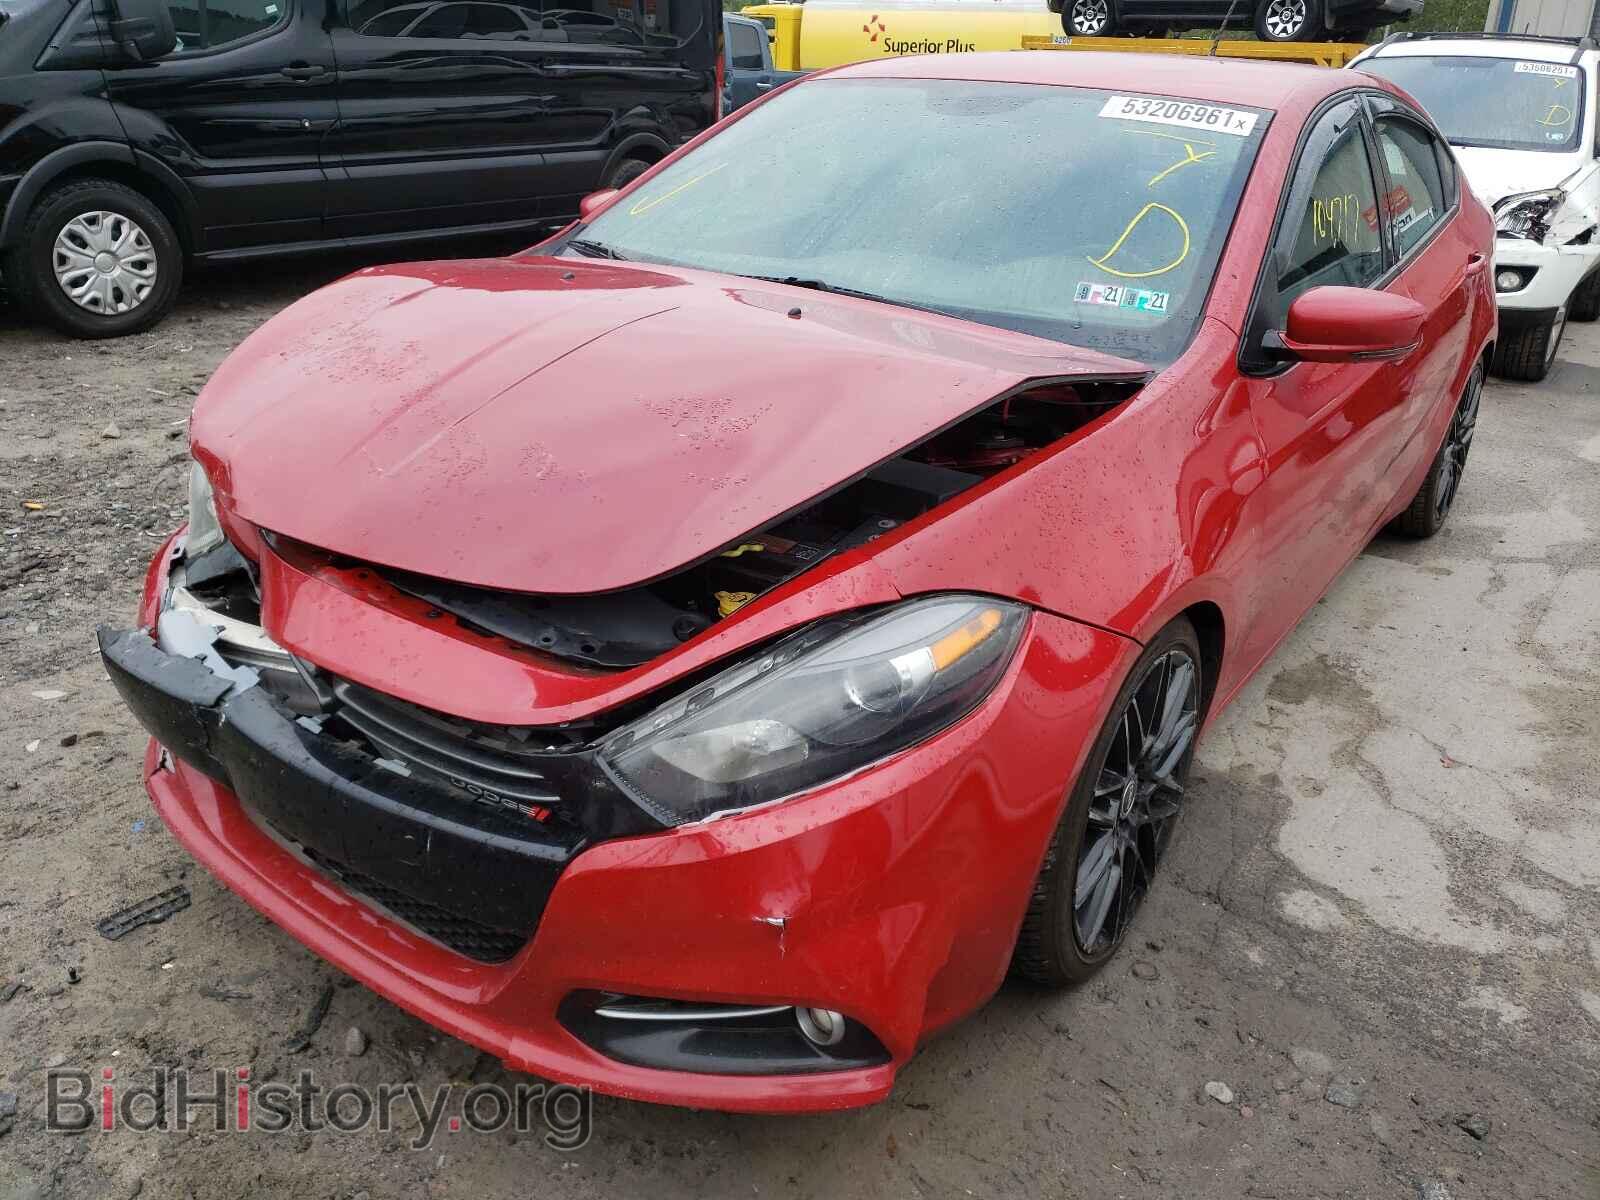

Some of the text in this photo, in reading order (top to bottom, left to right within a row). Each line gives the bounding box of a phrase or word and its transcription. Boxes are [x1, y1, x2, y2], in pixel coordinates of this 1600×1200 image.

[884, 37, 975, 55] Superior Plus
[1105, 286, 1119, 302] 21
[1152, 293, 1166, 309] 21
